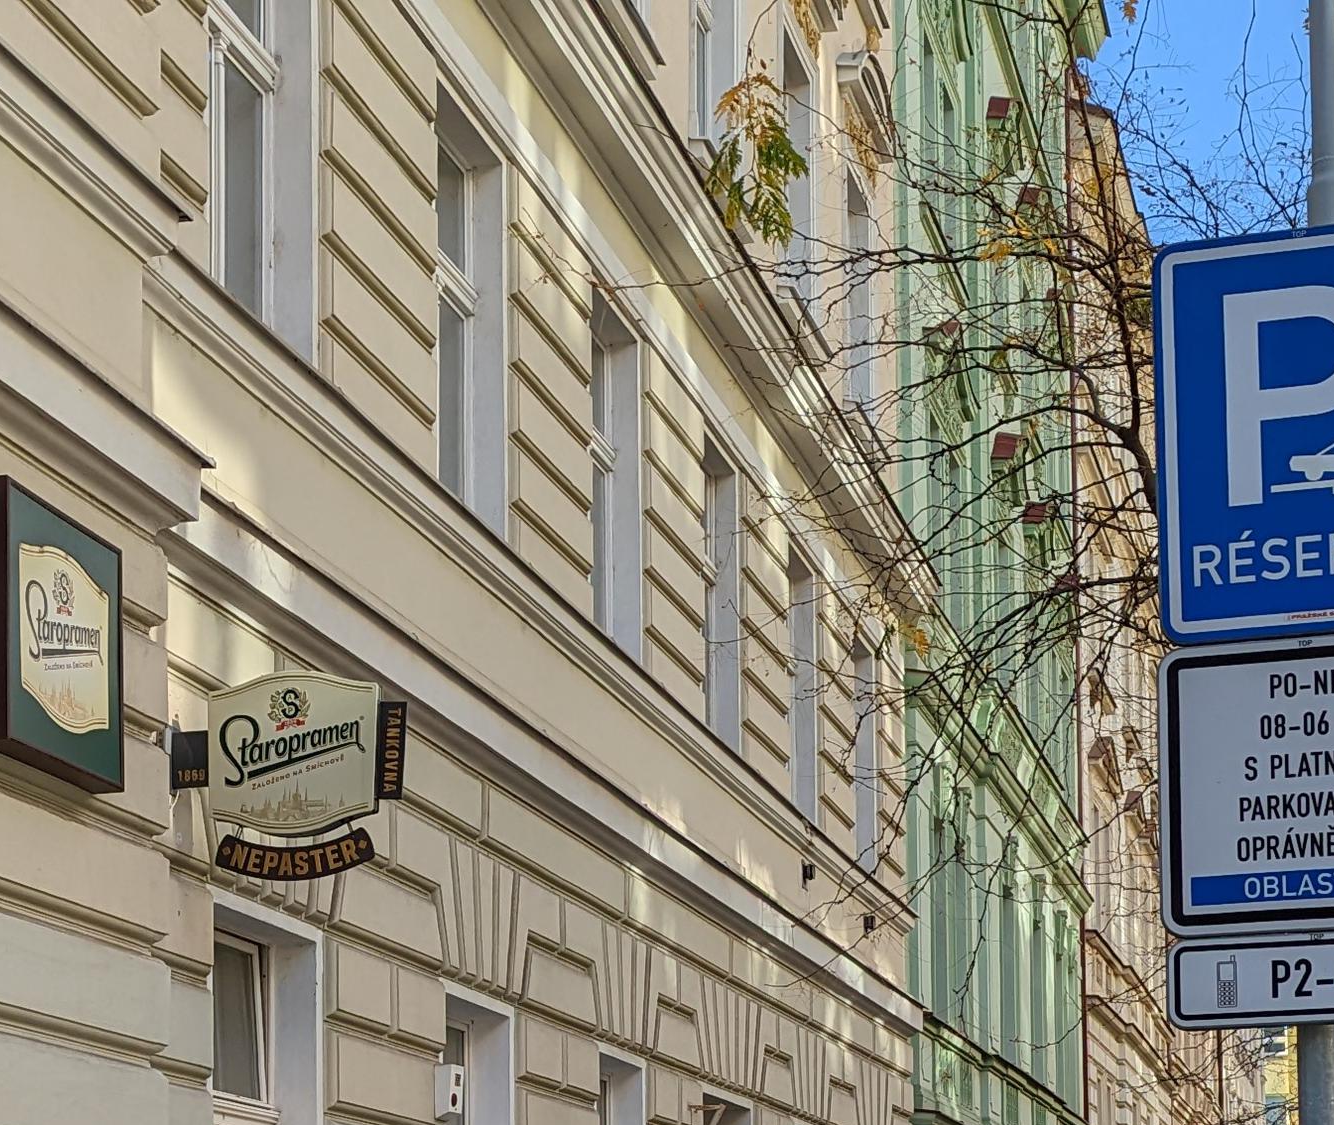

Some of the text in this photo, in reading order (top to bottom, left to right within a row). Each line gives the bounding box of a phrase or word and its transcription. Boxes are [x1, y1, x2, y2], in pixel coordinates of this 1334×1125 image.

[25, 580, 104, 666] Staropramen
[1298, 639, 1313, 647] TOP
[1260, 710, 1330, 740] 08-06
[219, 714, 366, 787] Staropramen
[383, 707, 402, 793] TANKOVNA
[177, 769, 205, 782] 1869
[1244, 756, 1258, 782] S
[230, 838, 361, 877] NEPASTER
